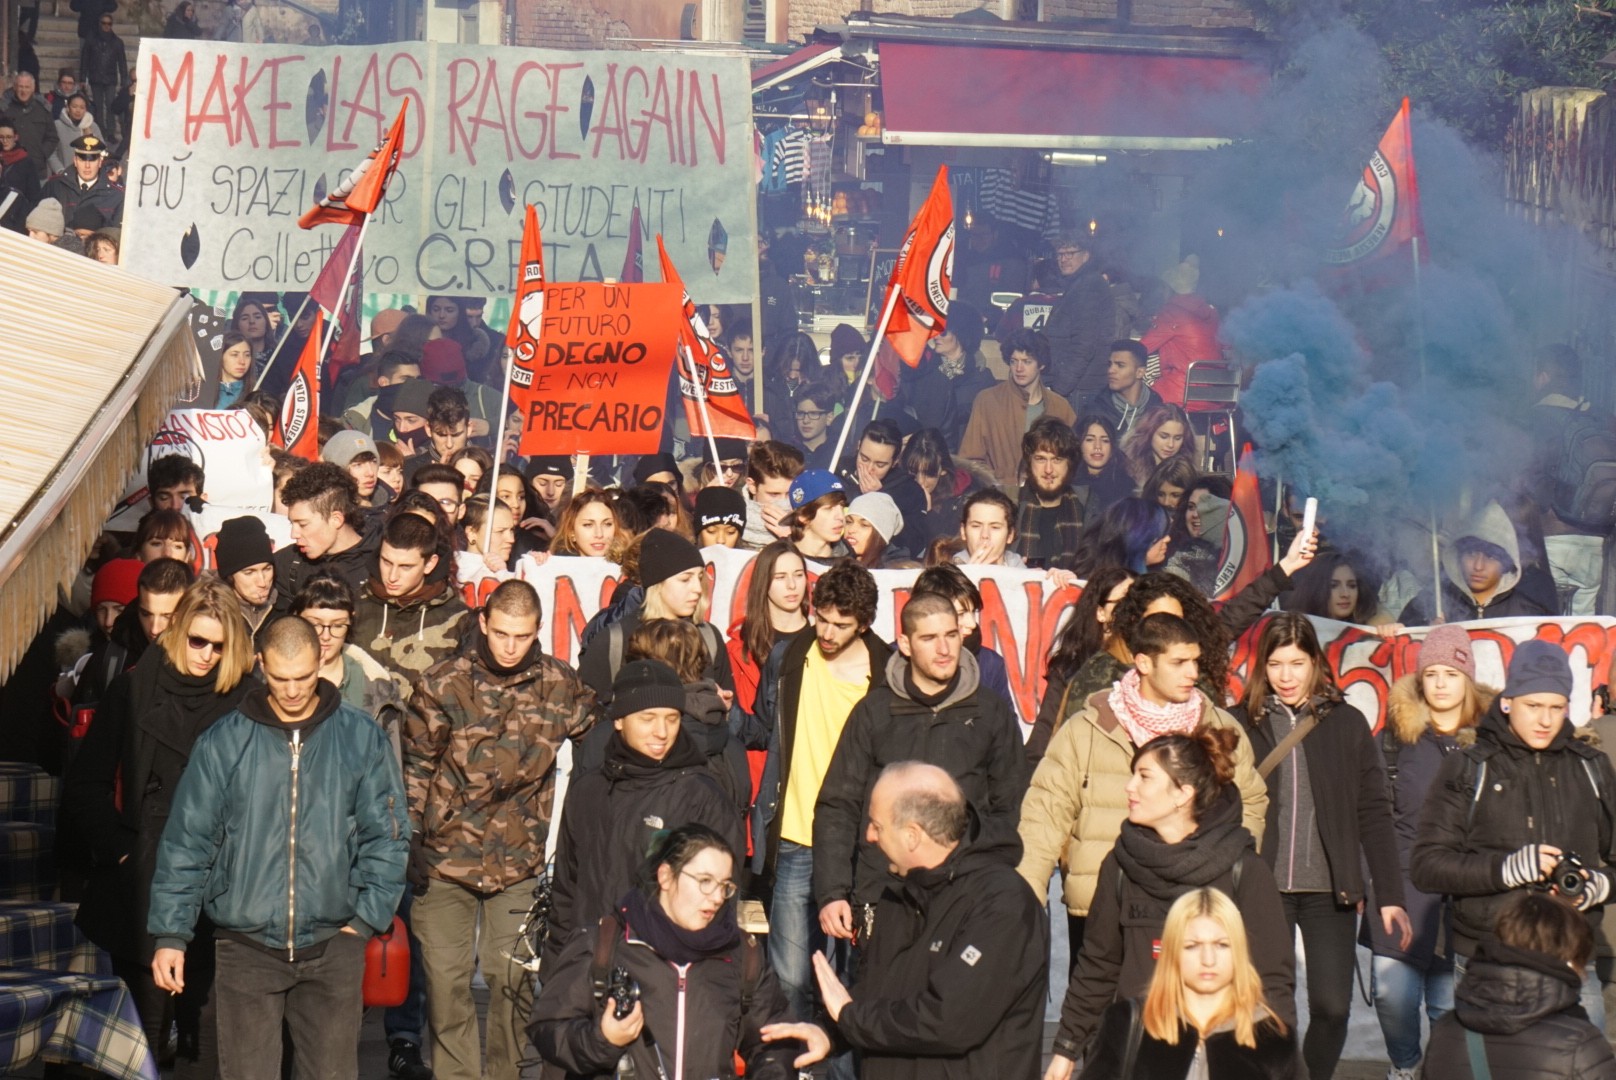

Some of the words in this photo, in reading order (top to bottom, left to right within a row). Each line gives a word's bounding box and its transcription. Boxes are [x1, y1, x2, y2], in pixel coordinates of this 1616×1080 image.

[144, 50, 306, 150] MAKE
[447, 56, 585, 167] RAGE
[590, 62, 727, 168] AGAIN
[210, 164, 307, 217] SPAZI
[434, 173, 487, 232] GLI
[519, 179, 686, 243] STUDENTI
[545, 286, 586, 311] PER
[603, 286, 631, 309] UN
[543, 313, 631, 338] FUTURO
[543, 341, 648, 368] DEGNO
[537, 374, 552, 392] E
[566, 371, 618, 391] NON
[526, 400, 663, 434] PRECARIO
